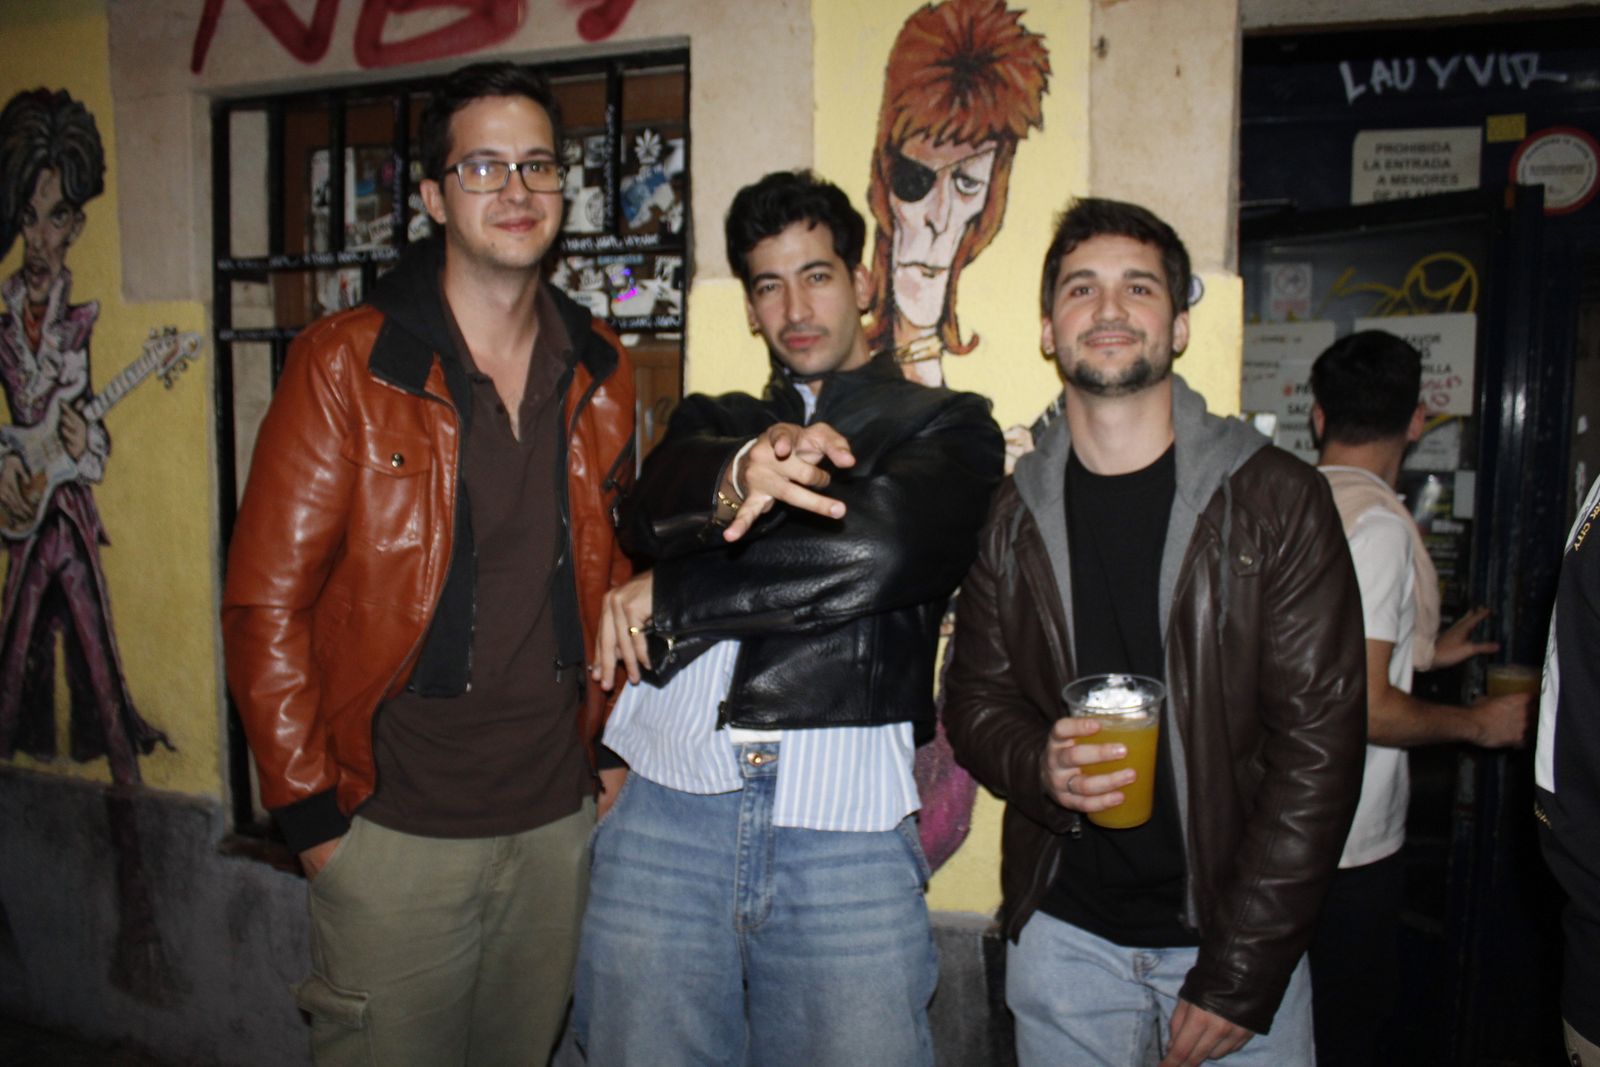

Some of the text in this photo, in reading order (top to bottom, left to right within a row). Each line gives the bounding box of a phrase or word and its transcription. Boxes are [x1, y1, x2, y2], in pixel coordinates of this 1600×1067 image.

[1338, 58, 1416, 105] LAU
[1425, 54, 1461, 91] Y
[1375, 142, 1452, 154] PROHIBIDA
[1363, 158, 1451, 171] LA ENTRADA
[1376, 174, 1460, 185] A MENORES
[1573, 521, 1592, 552] CITY
